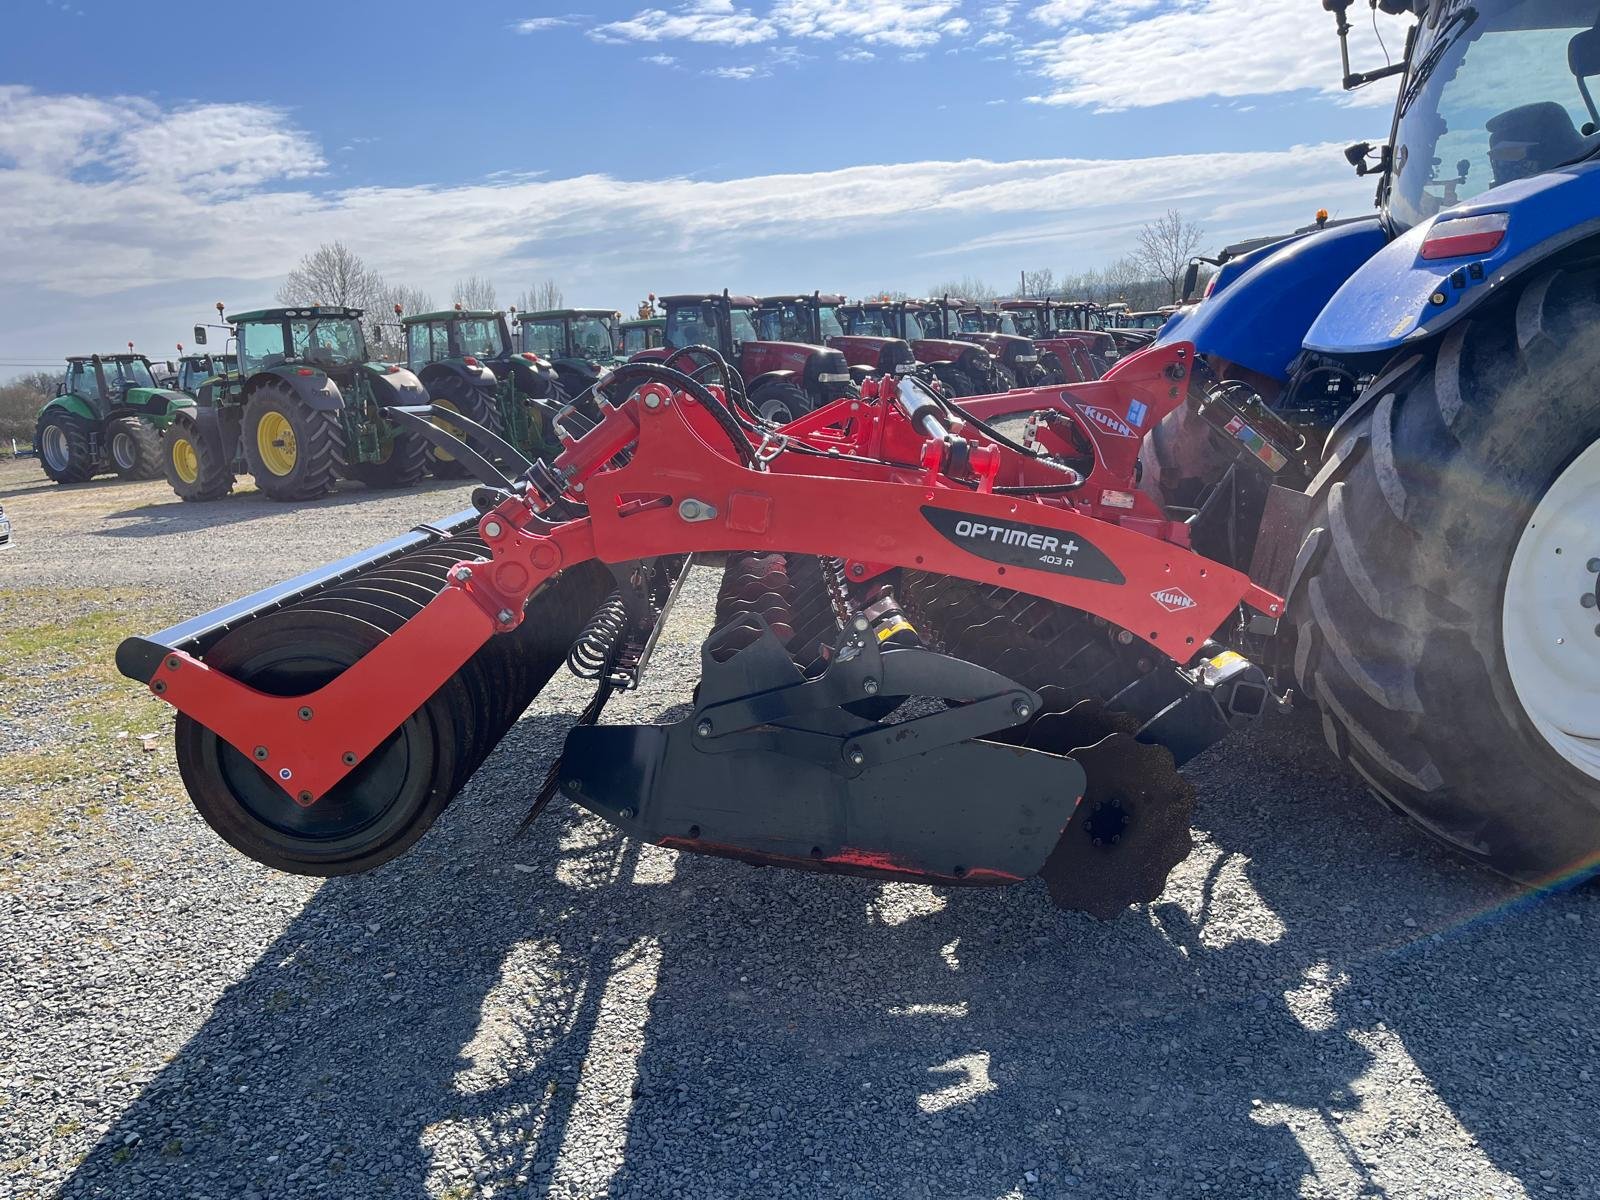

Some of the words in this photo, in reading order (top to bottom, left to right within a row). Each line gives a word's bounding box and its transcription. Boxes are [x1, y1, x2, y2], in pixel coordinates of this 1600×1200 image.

[1084, 405, 1131, 437] KUHN
[1039, 555, 1063, 566] 403
[1064, 559, 1074, 568] R
[1156, 591, 1191, 608] KUHN
